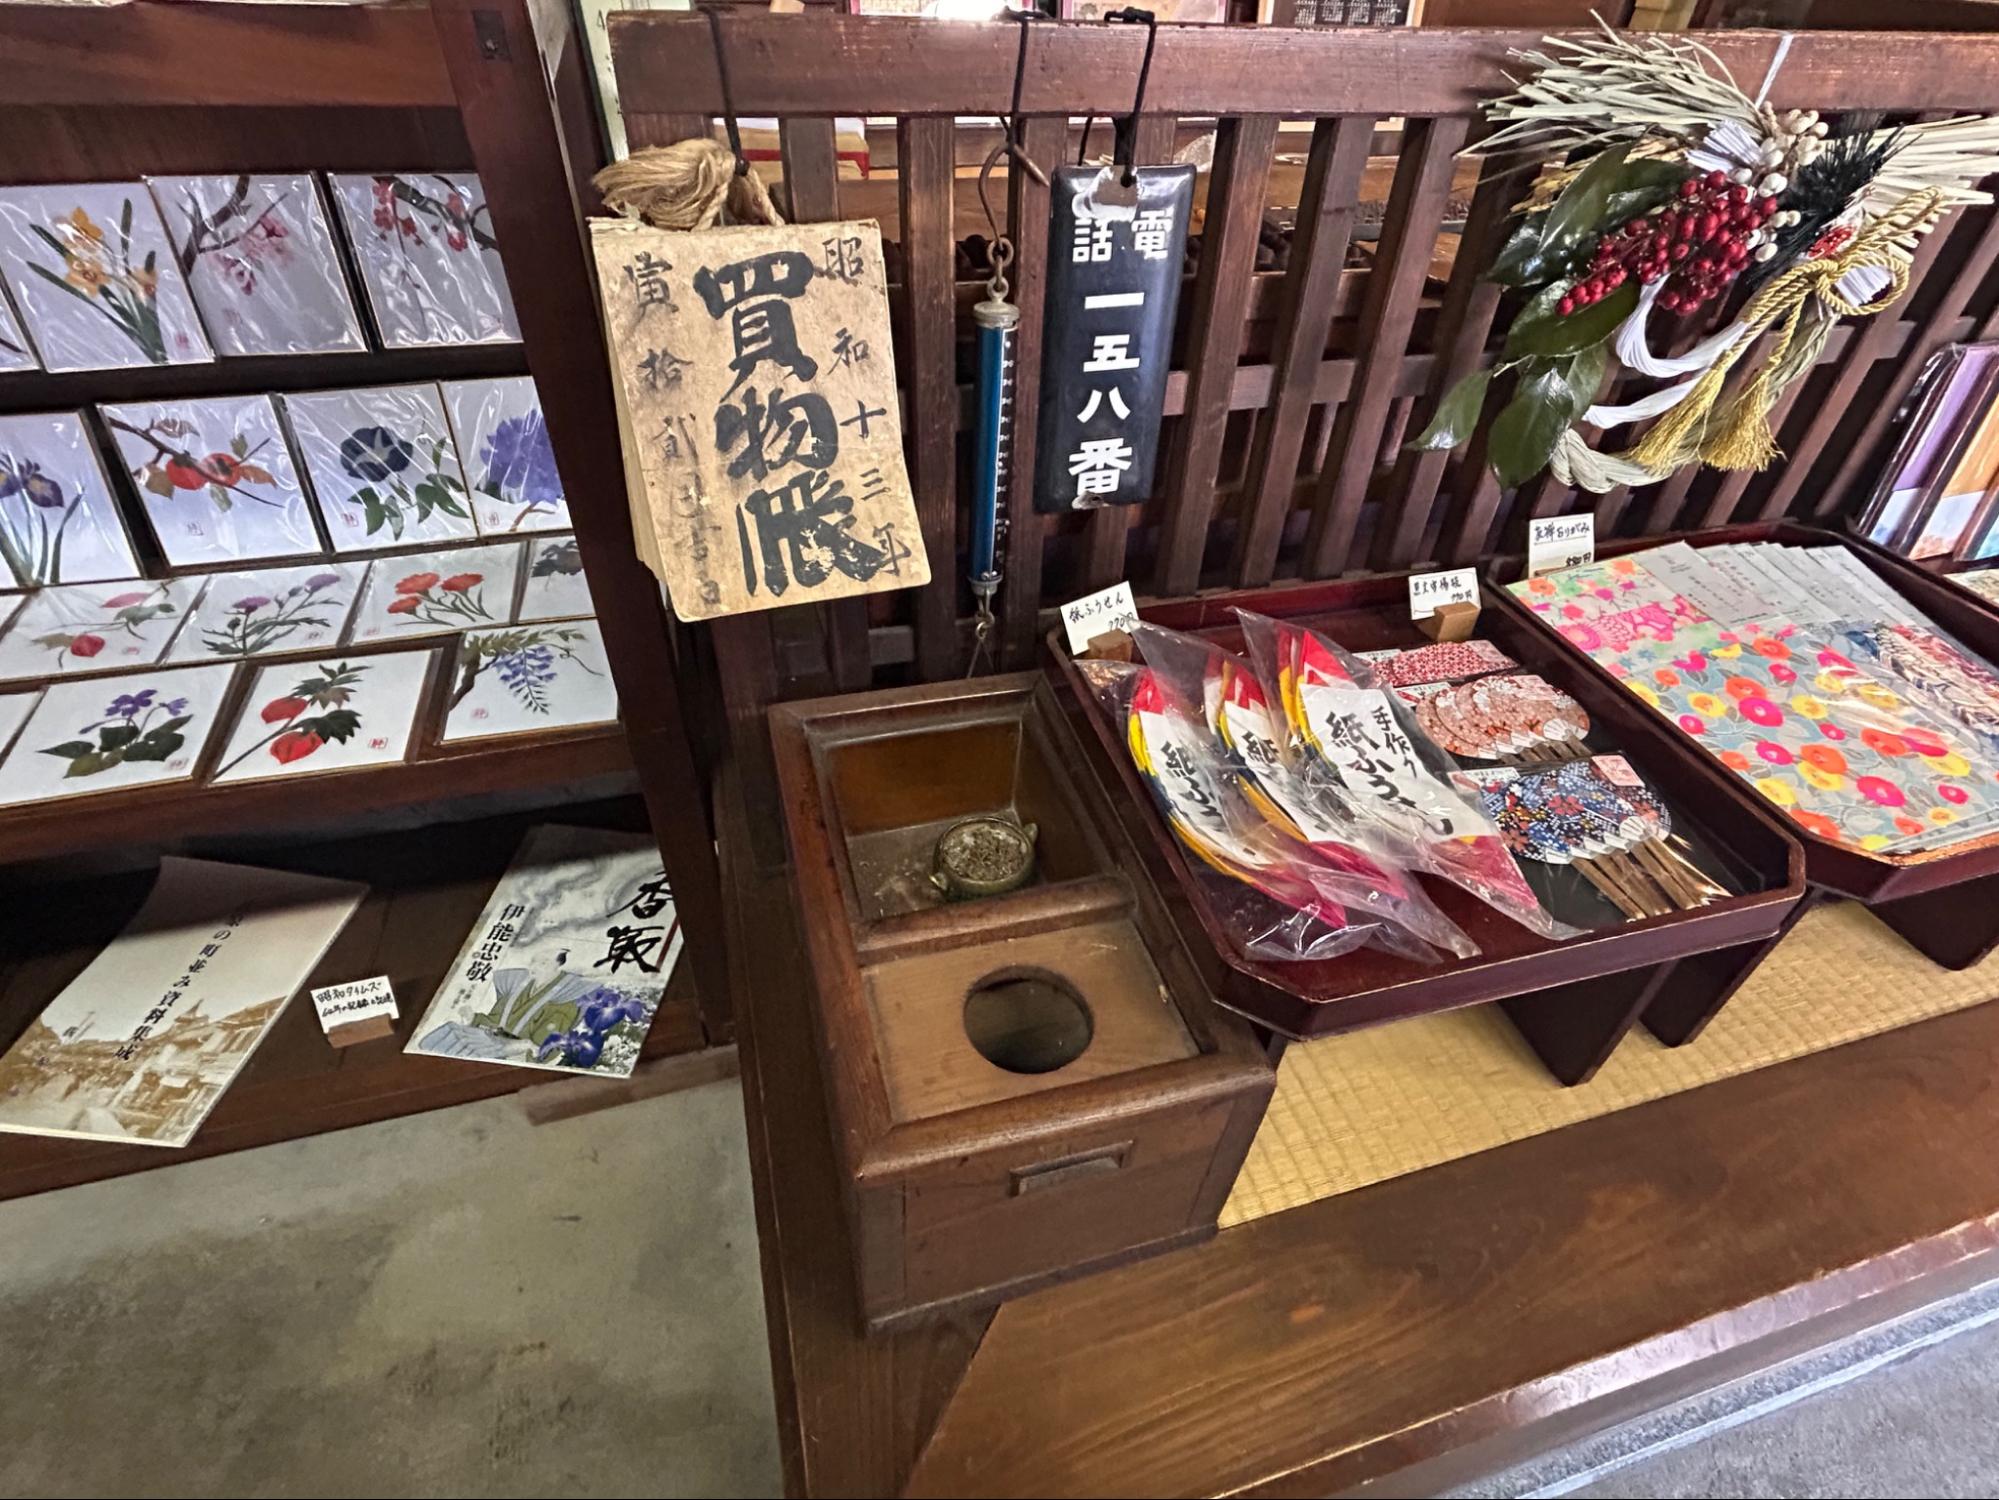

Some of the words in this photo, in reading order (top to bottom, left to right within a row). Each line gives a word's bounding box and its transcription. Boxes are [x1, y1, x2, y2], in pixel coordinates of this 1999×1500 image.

[1072, 210, 1173, 263] 電話
[817, 236, 911, 576] 昭和十三年
[1067, 292, 1145, 497] 一五八番
[1371, 705, 1418, 779] 手作り
[465, 903, 526, 982] 伊能忠敬
